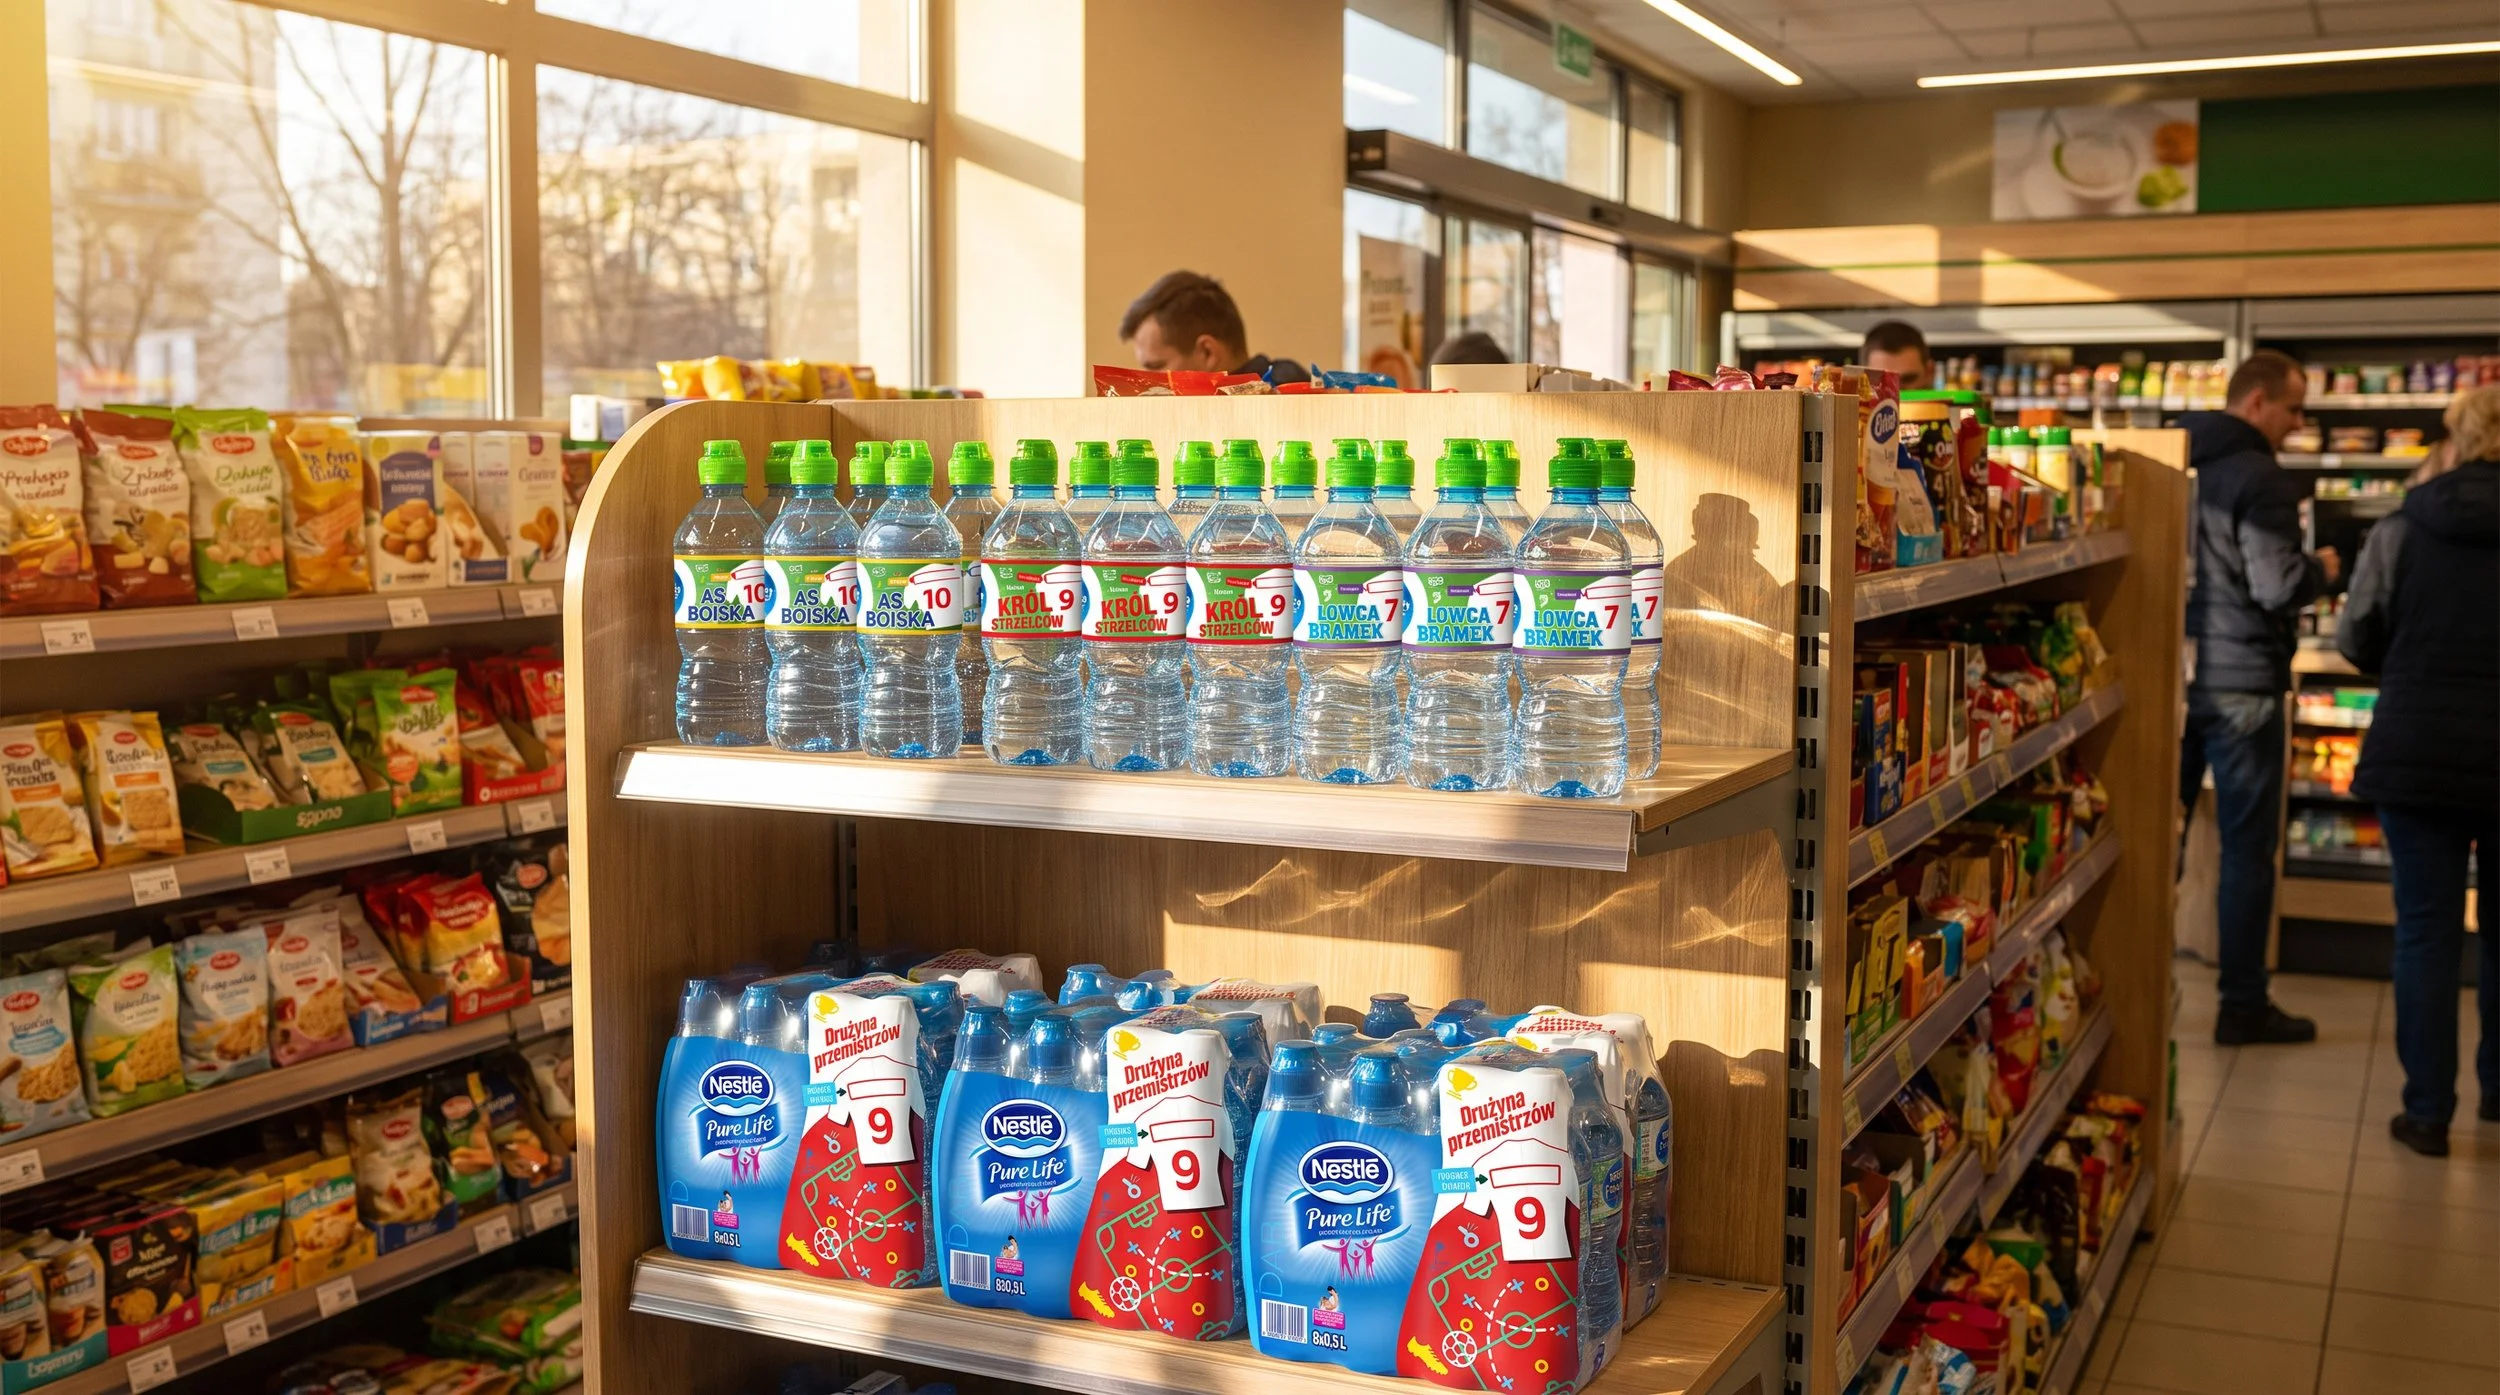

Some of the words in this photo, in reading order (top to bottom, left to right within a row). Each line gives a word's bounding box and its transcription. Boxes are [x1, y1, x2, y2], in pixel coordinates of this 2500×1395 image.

[701, 588, 726, 604] AS
[795, 590, 819, 606] AS
[877, 592, 902, 610] AS
[923, 587, 952, 610] 10
[997, 589, 1053, 617] KRÓL
[1058, 589, 1075, 611] 9
[1101, 591, 1158, 620] KRÓL
[1163, 592, 1180, 614] 9
[687, 605, 756, 623] BOISKA
[781, 607, 850, 624] BOISKA
[866, 611, 936, 628] BOISKA
[1205, 594, 1264, 623] KRÓL
[1270, 594, 1287, 617] 9
[1384, 598, 1400, 622] 7
[1495, 600, 1512, 625] 7
[1604, 604, 1620, 630] 7
[1644, 596, 1660, 621] 7
[1307, 622, 1384, 641] BRAMEK
[1417, 625, 1495, 643] BRAMEK
[1523, 628, 1604, 647] BRAMEK
[824, 1016, 878, 1048] Drużyna
[814, 1023, 901, 1074] przemistrzów
[1124, 1052, 1184, 1085] Drużyna
[709, 1074, 764, 1096] Nestlé
[1113, 1059, 1210, 1113] przemistrzów
[1460, 1091, 1526, 1128] Drużyna
[705, 1119, 743, 1141] Pure
[867, 1107, 895, 1146] 9
[993, 1114, 1054, 1137] Nestlé
[1447, 1100, 1556, 1157] przemistrzów
[988, 1162, 1030, 1184] Pure
[1171, 1149, 1201, 1191] 9
[1311, 1157, 1380, 1181] Nestlé
[1305, 1207, 1354, 1230] Pure
[1514, 1196, 1547, 1241] 9
